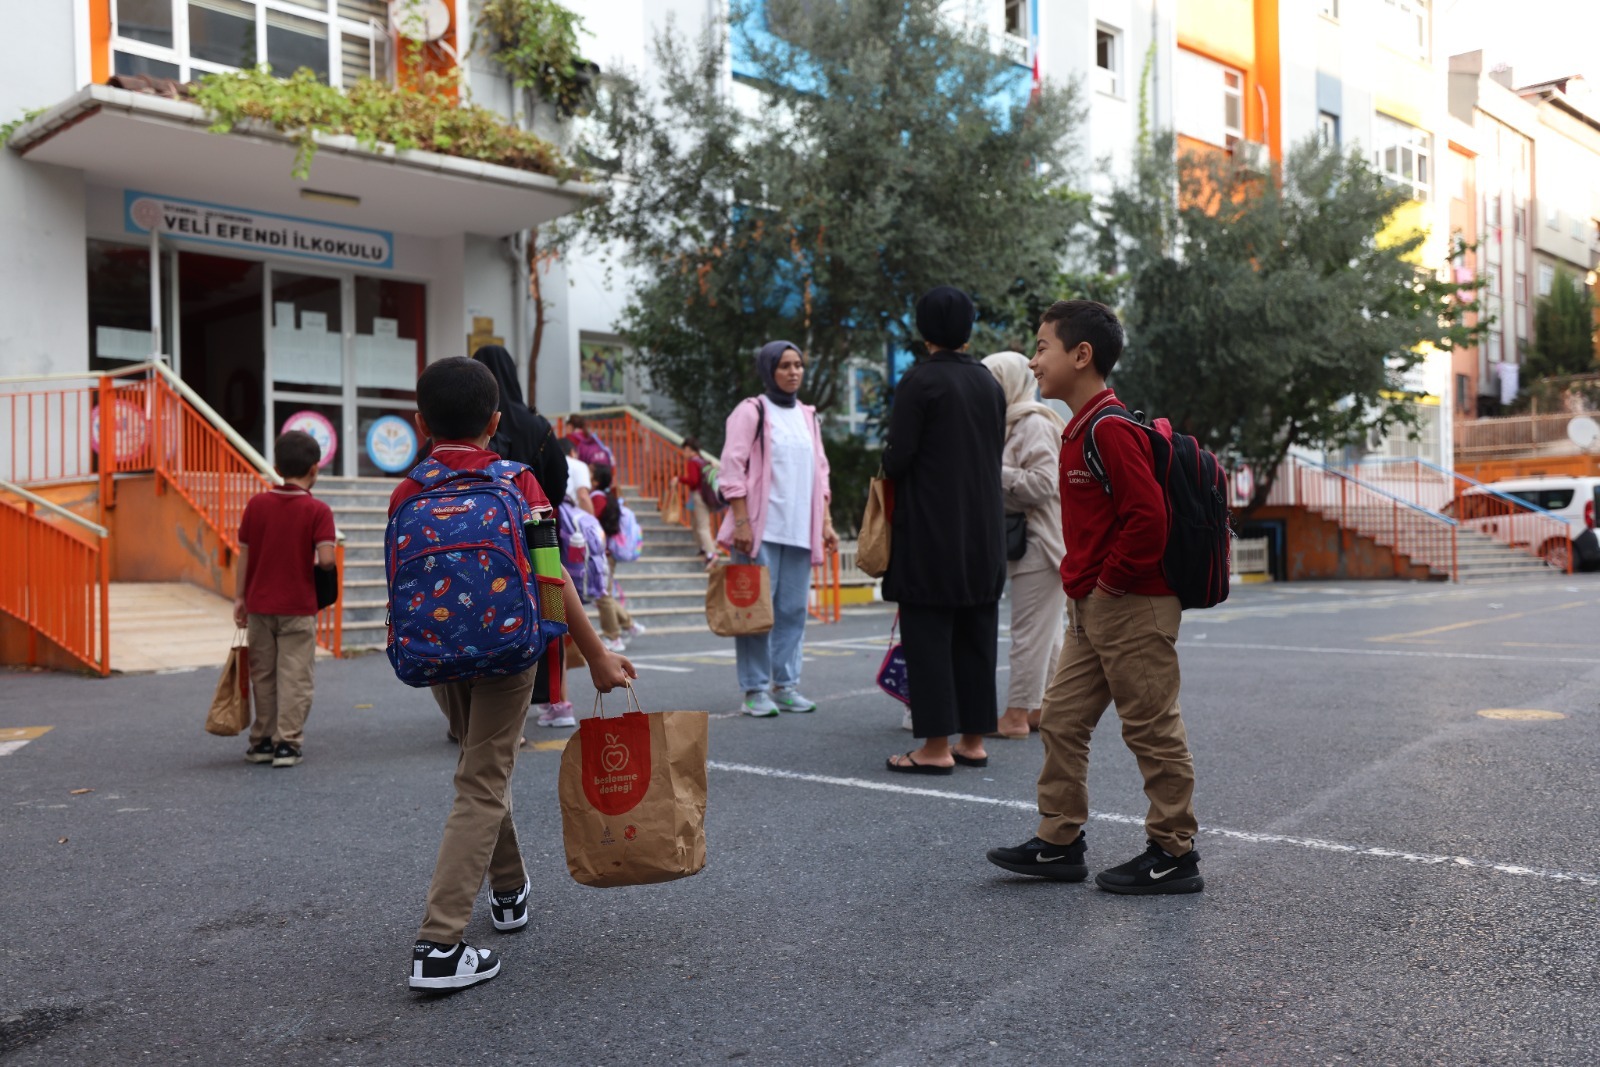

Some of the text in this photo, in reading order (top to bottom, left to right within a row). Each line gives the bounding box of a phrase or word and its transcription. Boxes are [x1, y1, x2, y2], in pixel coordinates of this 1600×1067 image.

[164, 215, 383, 260] VELİ EFENDİ İLKOKULU
